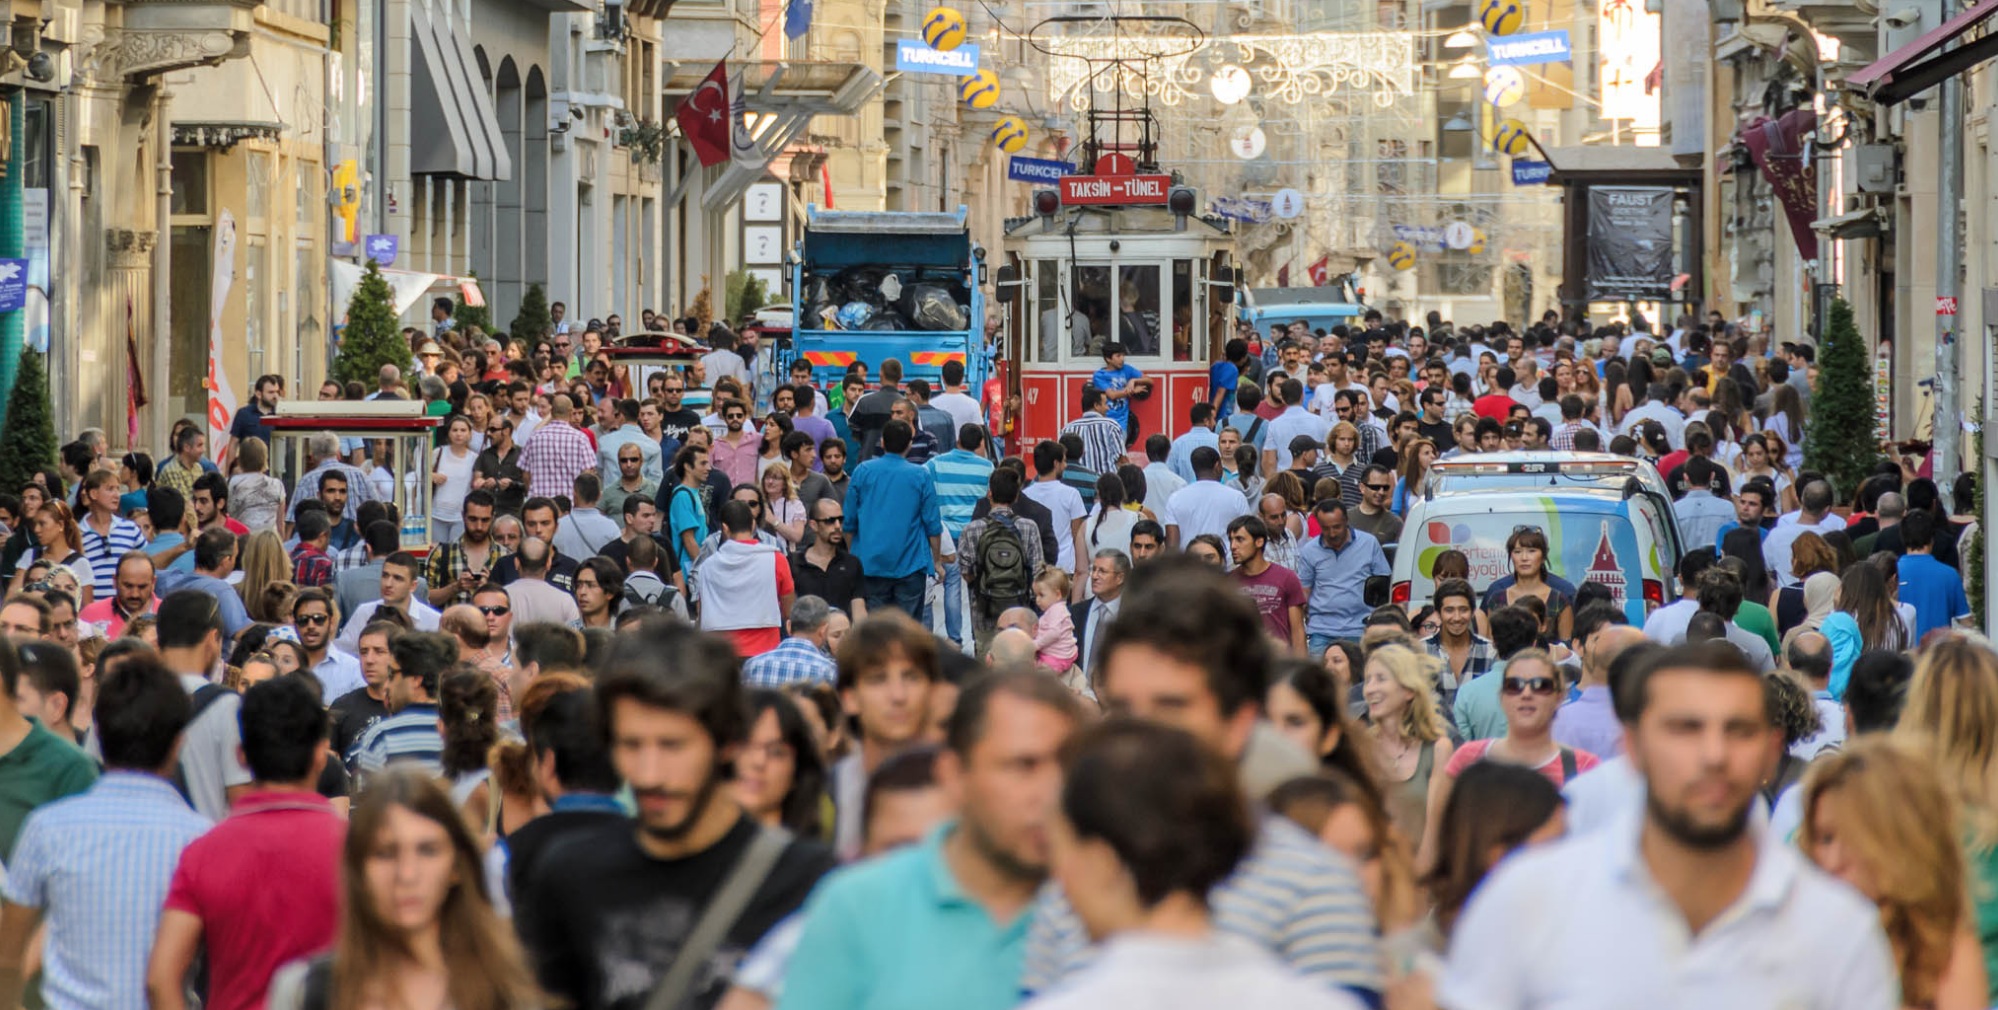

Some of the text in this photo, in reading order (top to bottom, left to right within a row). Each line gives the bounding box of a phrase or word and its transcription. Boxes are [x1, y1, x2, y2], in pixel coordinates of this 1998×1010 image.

[1111, 155, 1117, 174] 1
[1124, 178, 1163, 197] TÜNEL
[1608, 194, 1653, 206] FAUST
[1027, 387, 1039, 404] 47
[1191, 386, 1203, 404] 47
[1468, 560, 1511, 580] eyoğlu
